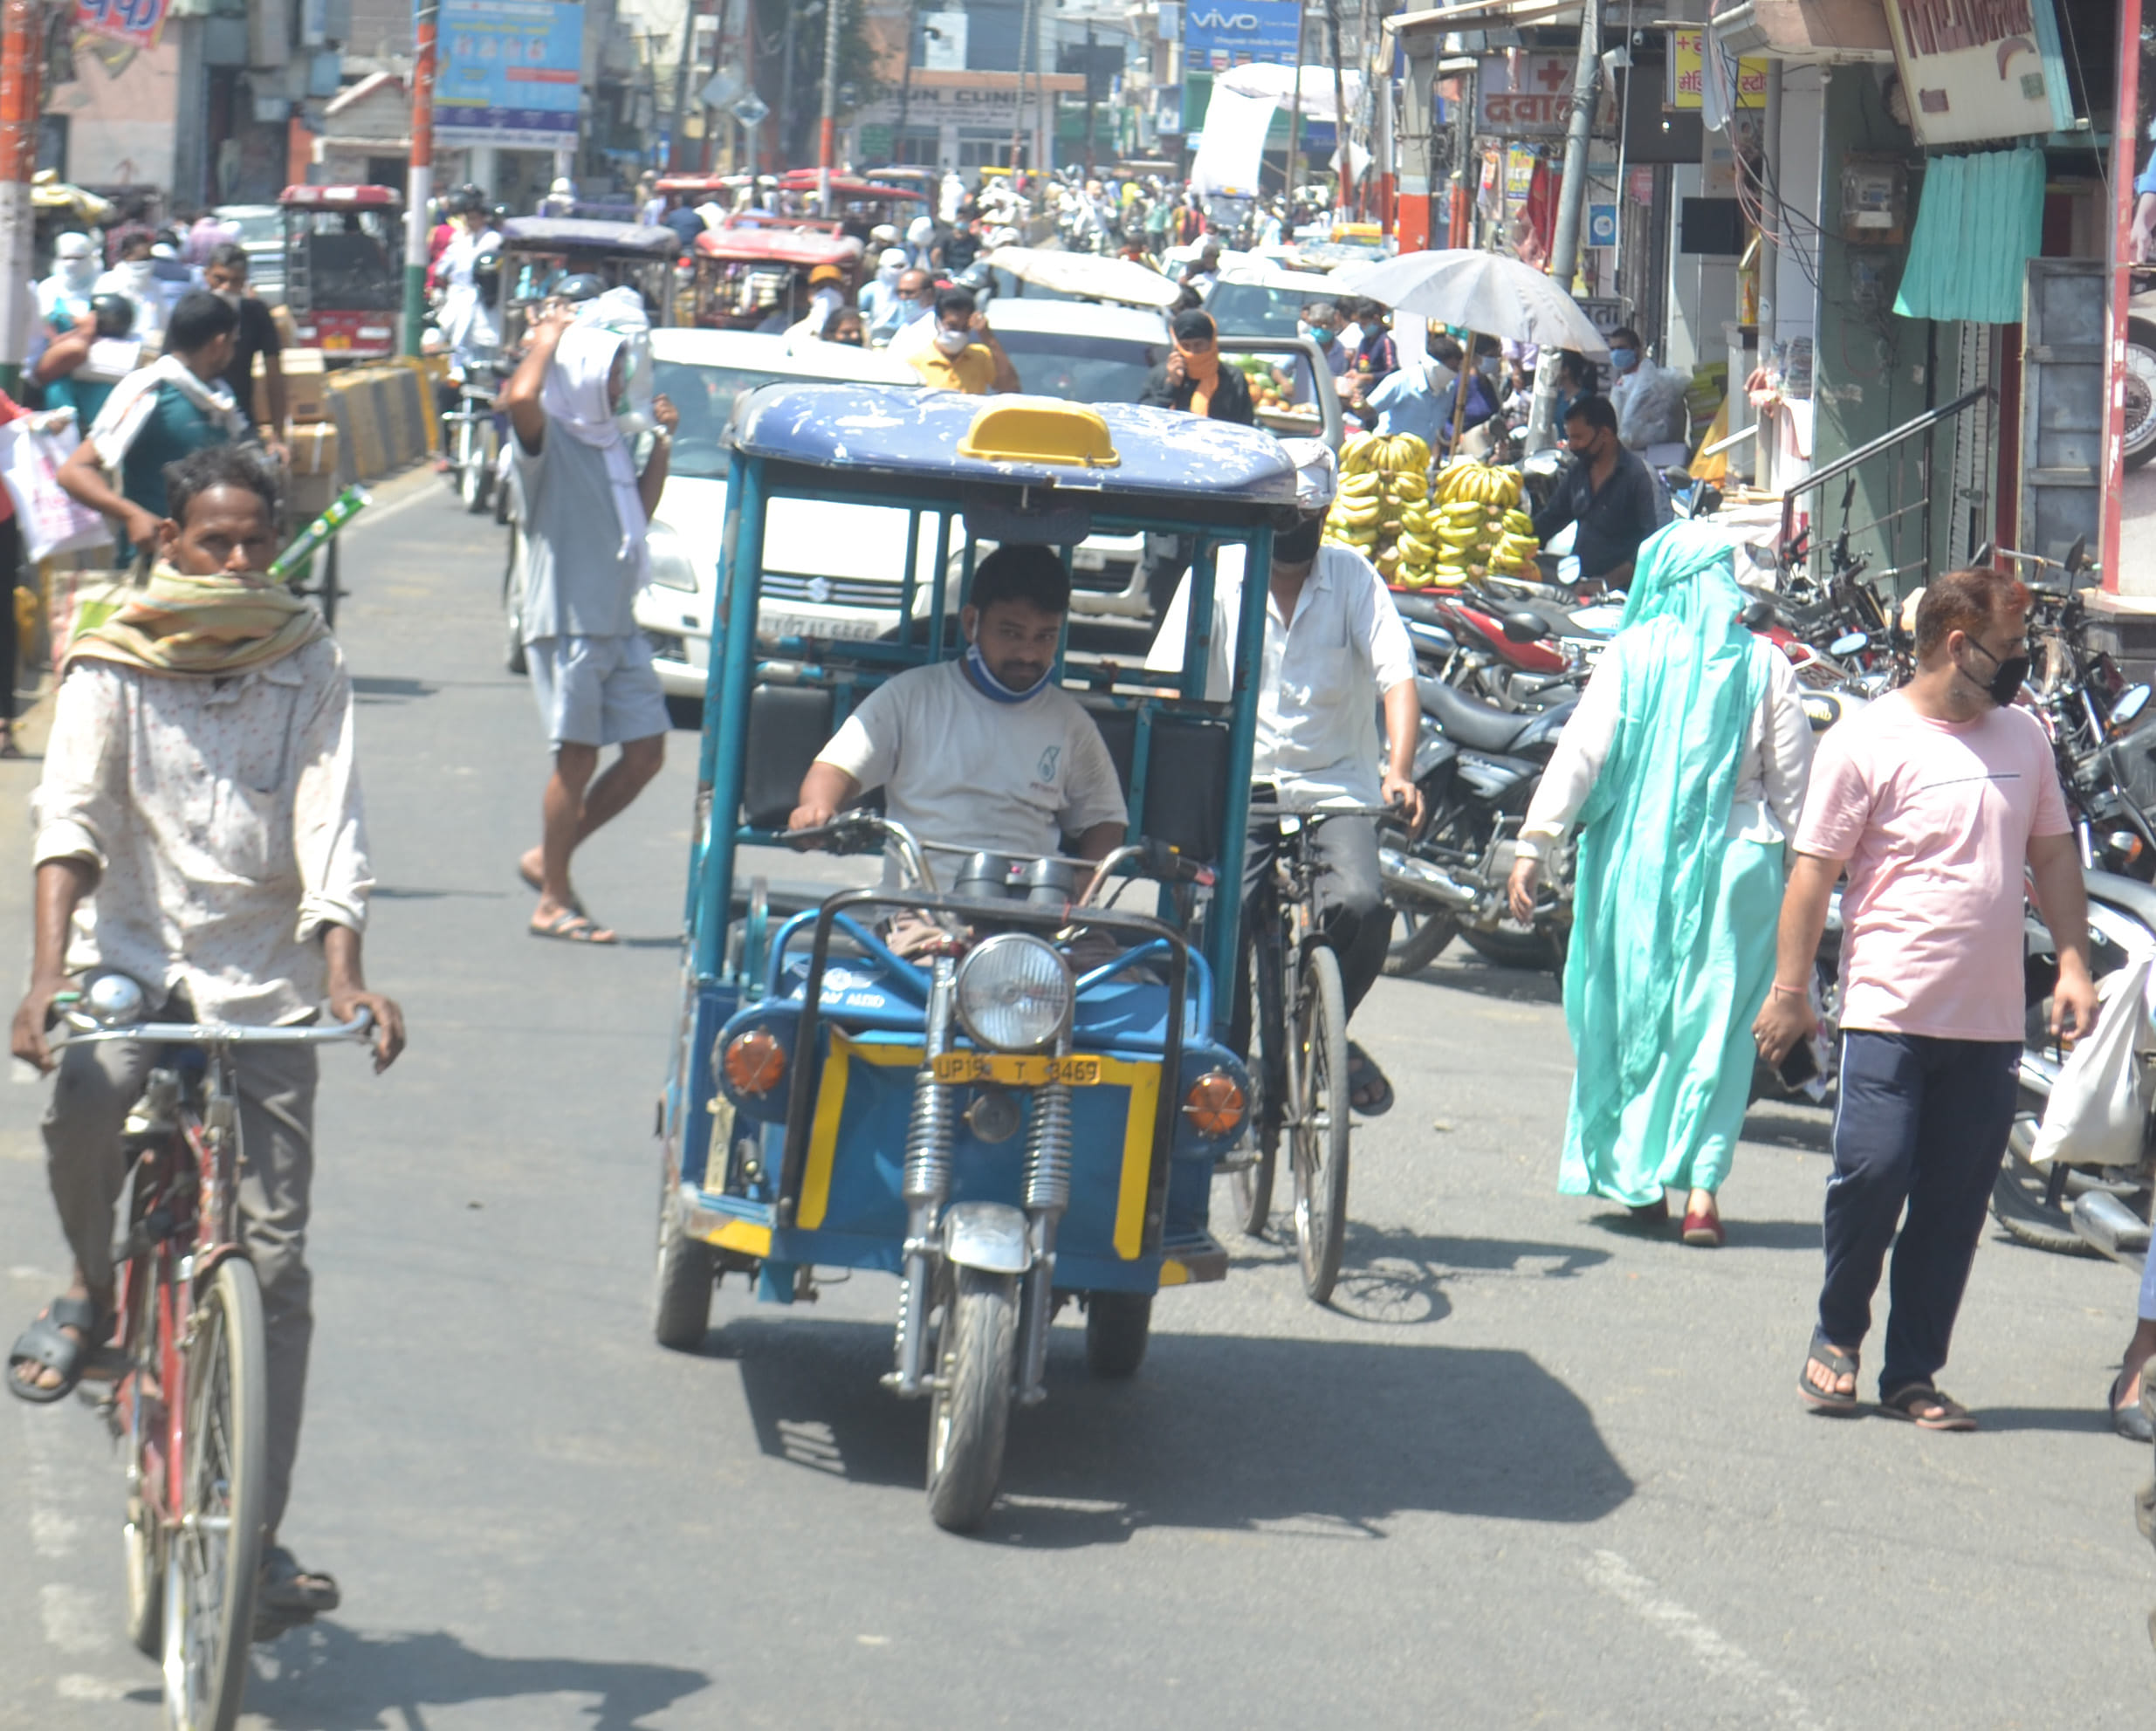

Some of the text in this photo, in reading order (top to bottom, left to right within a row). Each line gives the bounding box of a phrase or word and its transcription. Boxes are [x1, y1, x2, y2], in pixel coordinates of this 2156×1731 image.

[1190, 8, 1258, 31] vivo
[954, 89, 1037, 105] CLINIC
[1014, 1061, 1027, 1080] T
